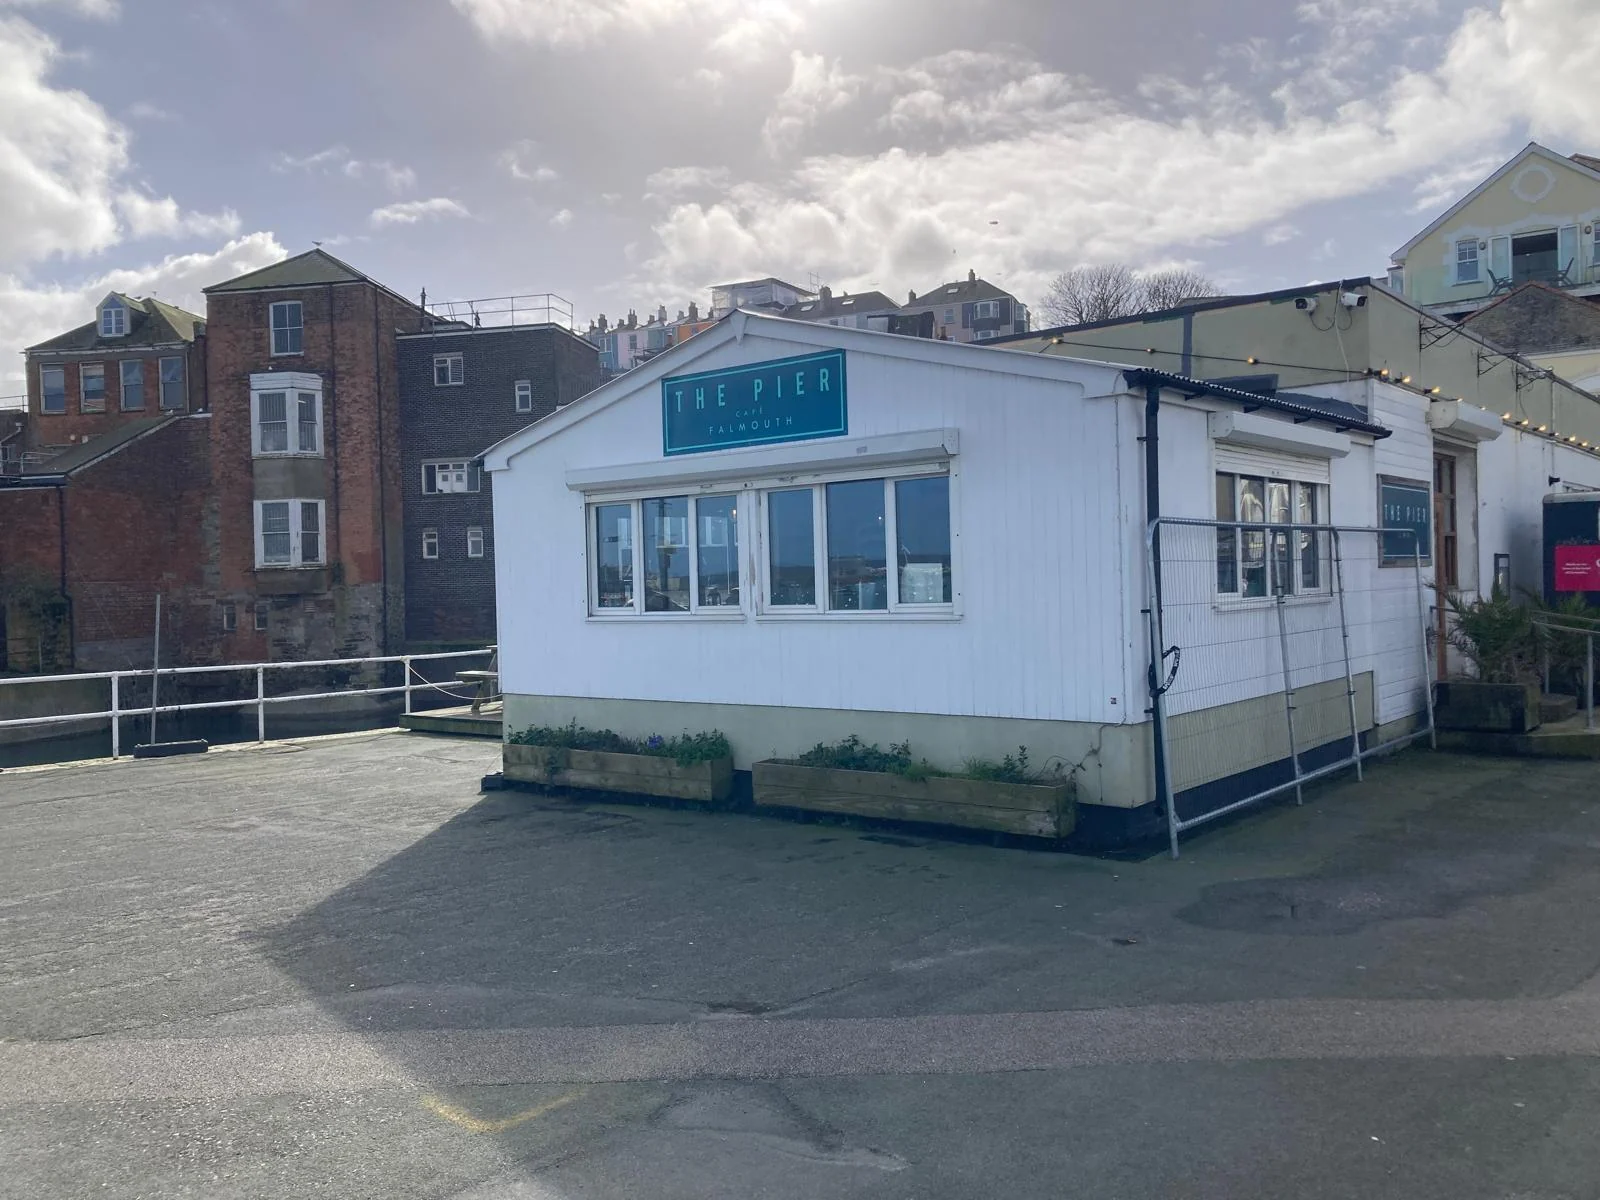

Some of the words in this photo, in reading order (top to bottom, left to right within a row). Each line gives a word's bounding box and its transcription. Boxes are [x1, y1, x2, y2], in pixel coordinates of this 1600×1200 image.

[675, 384, 726, 412] THE
[754, 368, 830, 401] PIER
[708, 416, 793, 436] FALMOUTH
[1384, 503, 1401, 521] THE
[1406, 505, 1427, 523] PIER
